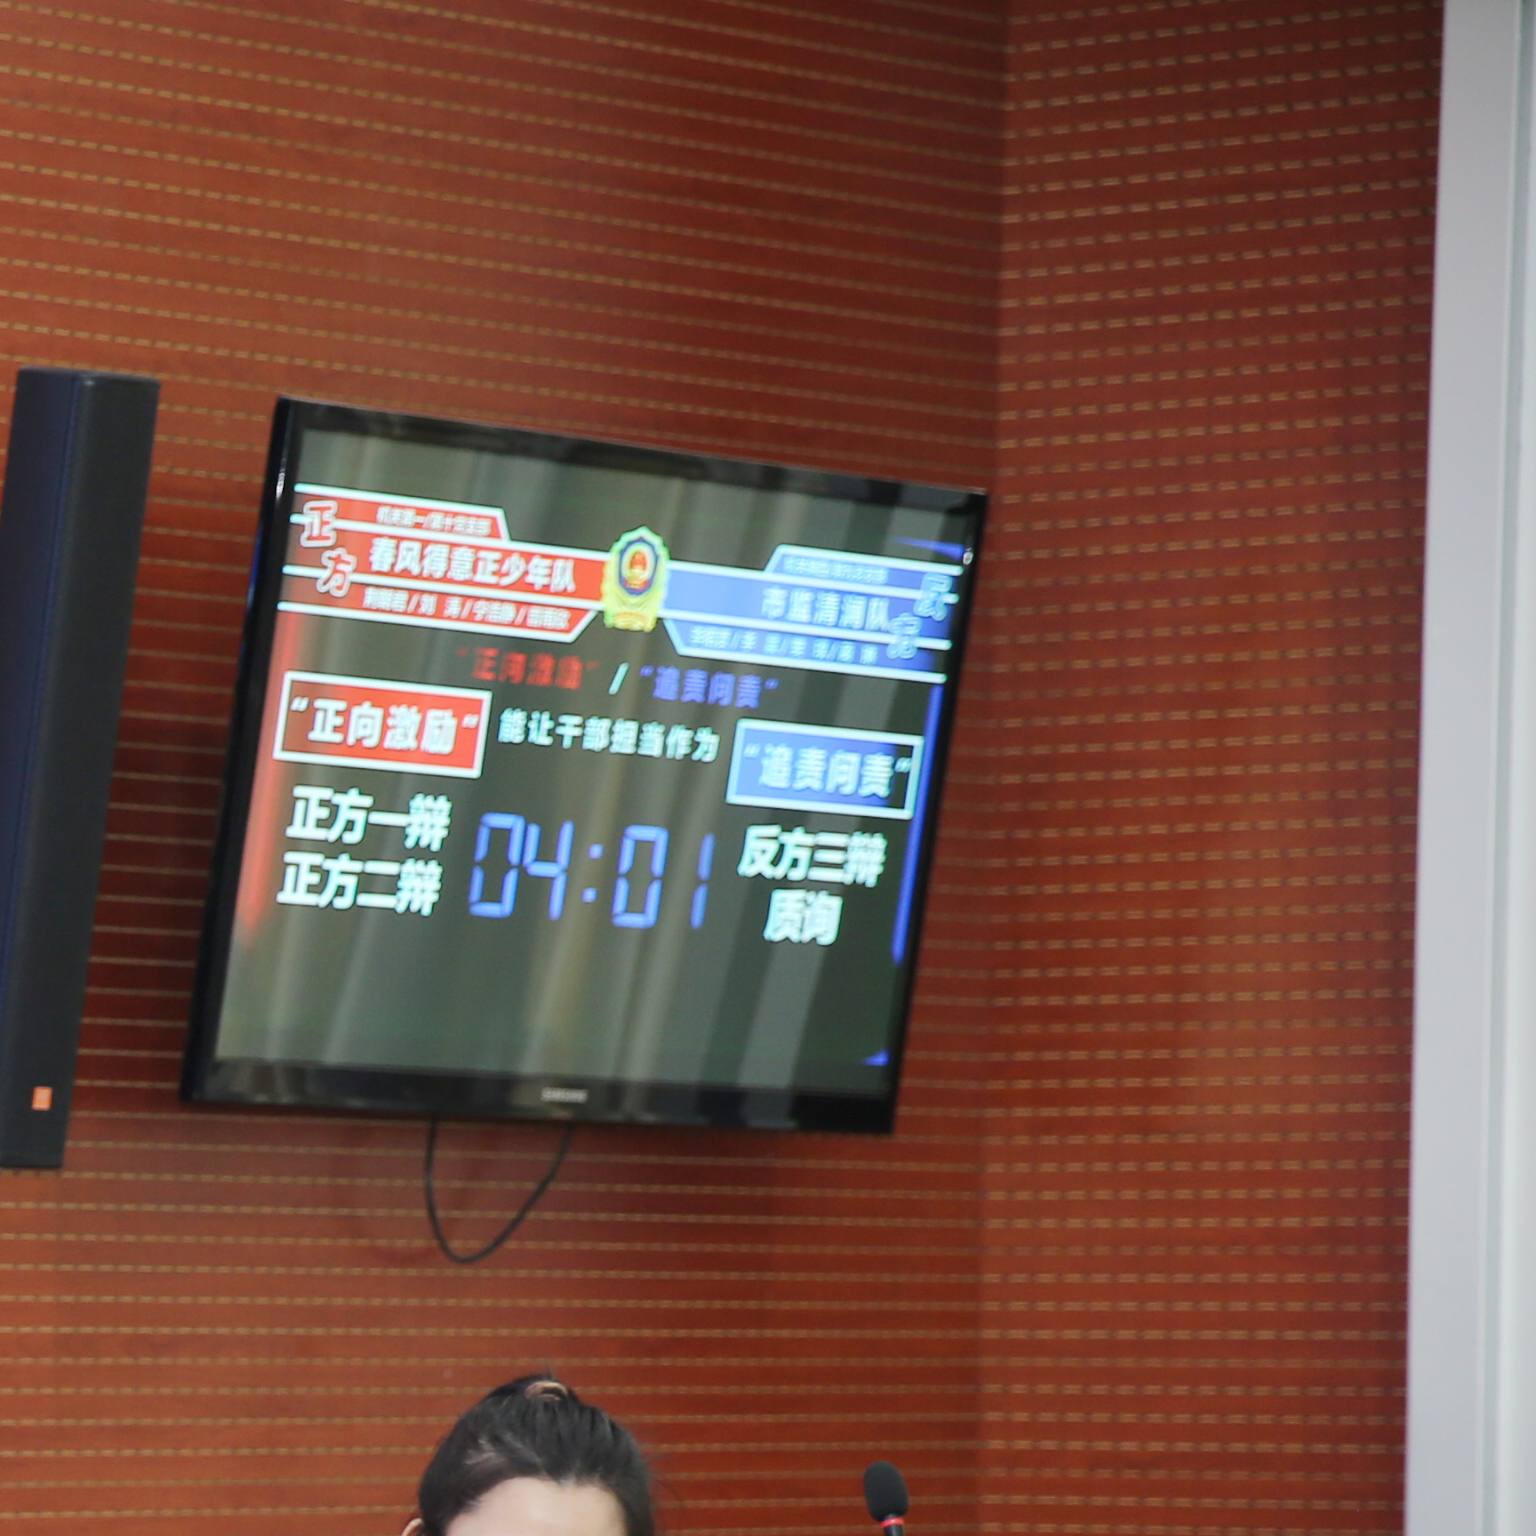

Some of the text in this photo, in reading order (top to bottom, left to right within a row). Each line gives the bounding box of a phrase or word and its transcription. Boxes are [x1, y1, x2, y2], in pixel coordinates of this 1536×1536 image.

[370, 537, 577, 593] 春风得意正少年队
[497, 707, 721, 763] 能让干部担当作为
[276, 850, 444, 917] 正方二辩
[285, 784, 887, 930] 正方一辩 04:01 反方三辩
